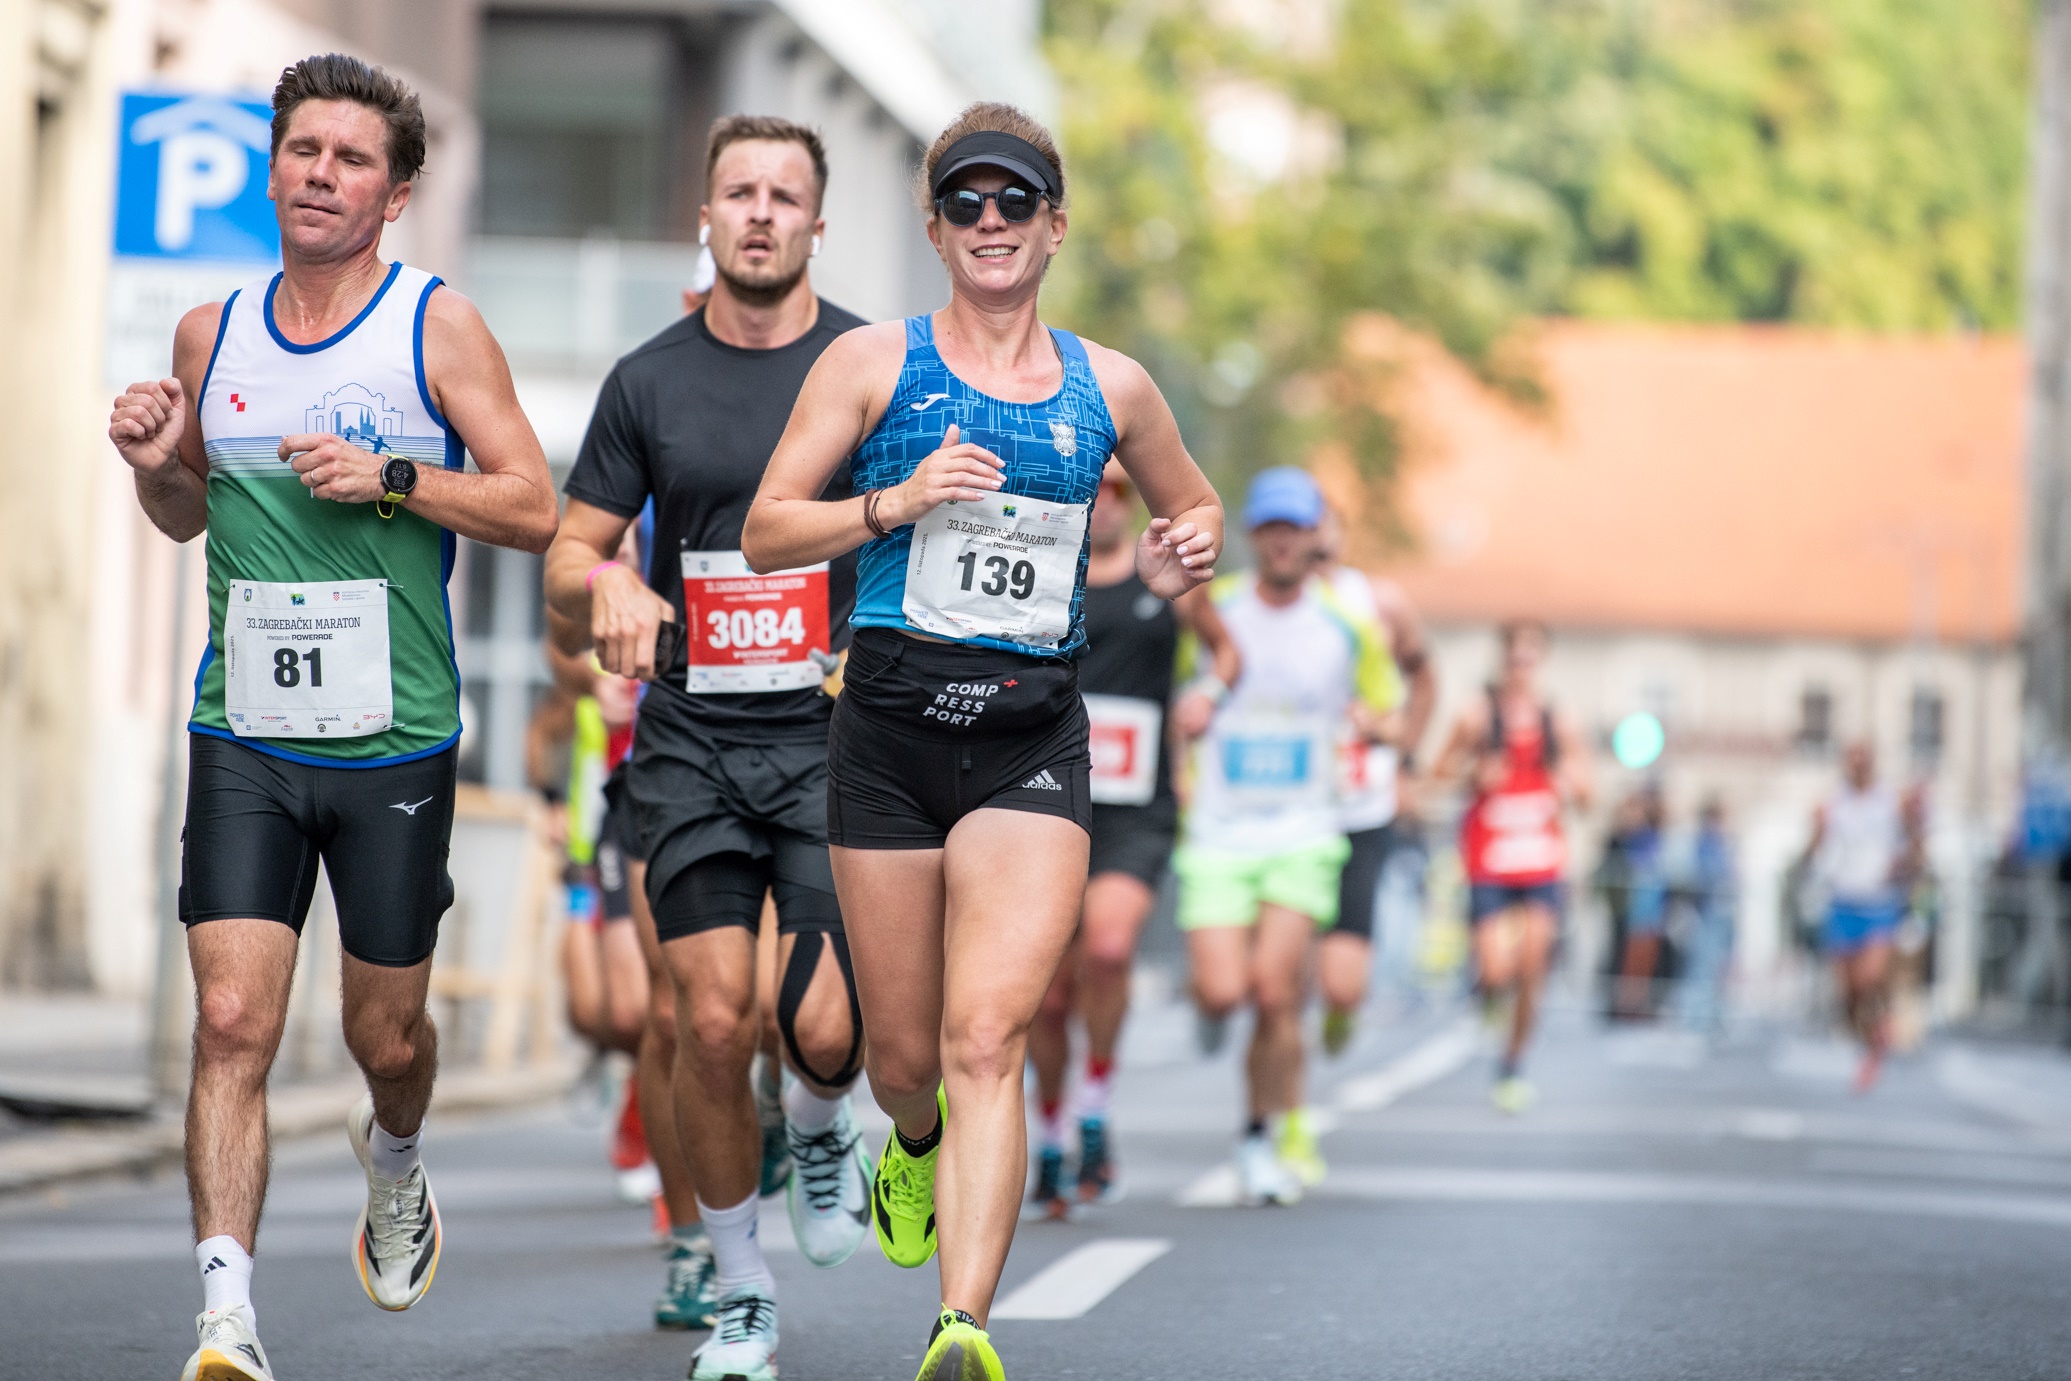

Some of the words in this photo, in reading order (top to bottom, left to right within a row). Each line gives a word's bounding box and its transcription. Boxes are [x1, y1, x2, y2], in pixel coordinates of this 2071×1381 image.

[154, 132, 250, 250] P
[993, 541, 1029, 553] POWERADE
[1016, 532, 1058, 546] MARATON
[957, 551, 1036, 601] 139
[315, 616, 361, 630] MARATON
[707, 606, 806, 649] 3084
[291, 633, 334, 641] POWERADE
[273, 647, 322, 688] 81
[946, 683, 999, 697] COMP
[934, 693, 985, 714] RESS
[922, 706, 977, 727] PORT
